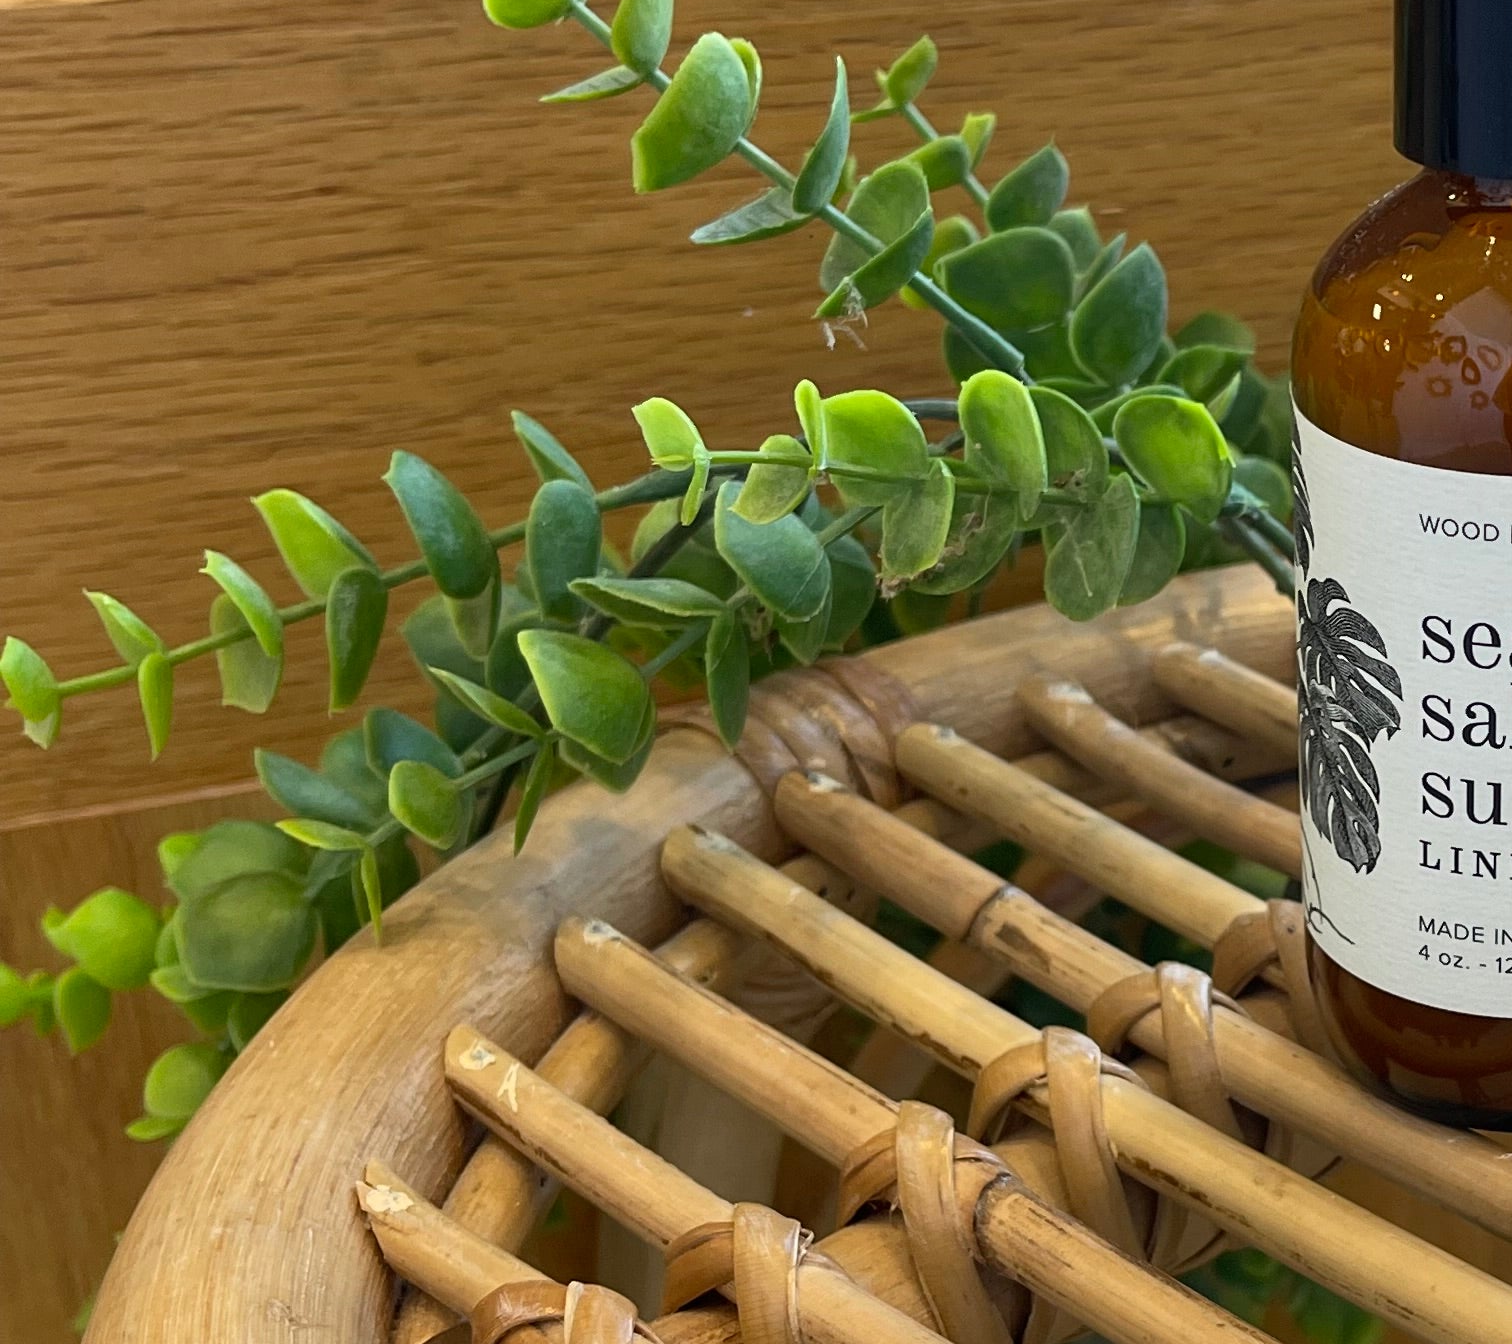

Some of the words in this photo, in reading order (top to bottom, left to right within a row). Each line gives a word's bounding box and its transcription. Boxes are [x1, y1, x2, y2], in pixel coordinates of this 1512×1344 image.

[1418, 512, 1501, 543] WOOD
[1418, 914, 1485, 945] MADE
[1418, 943, 1430, 961] 4
[1437, 951, 1471, 970] oz.
